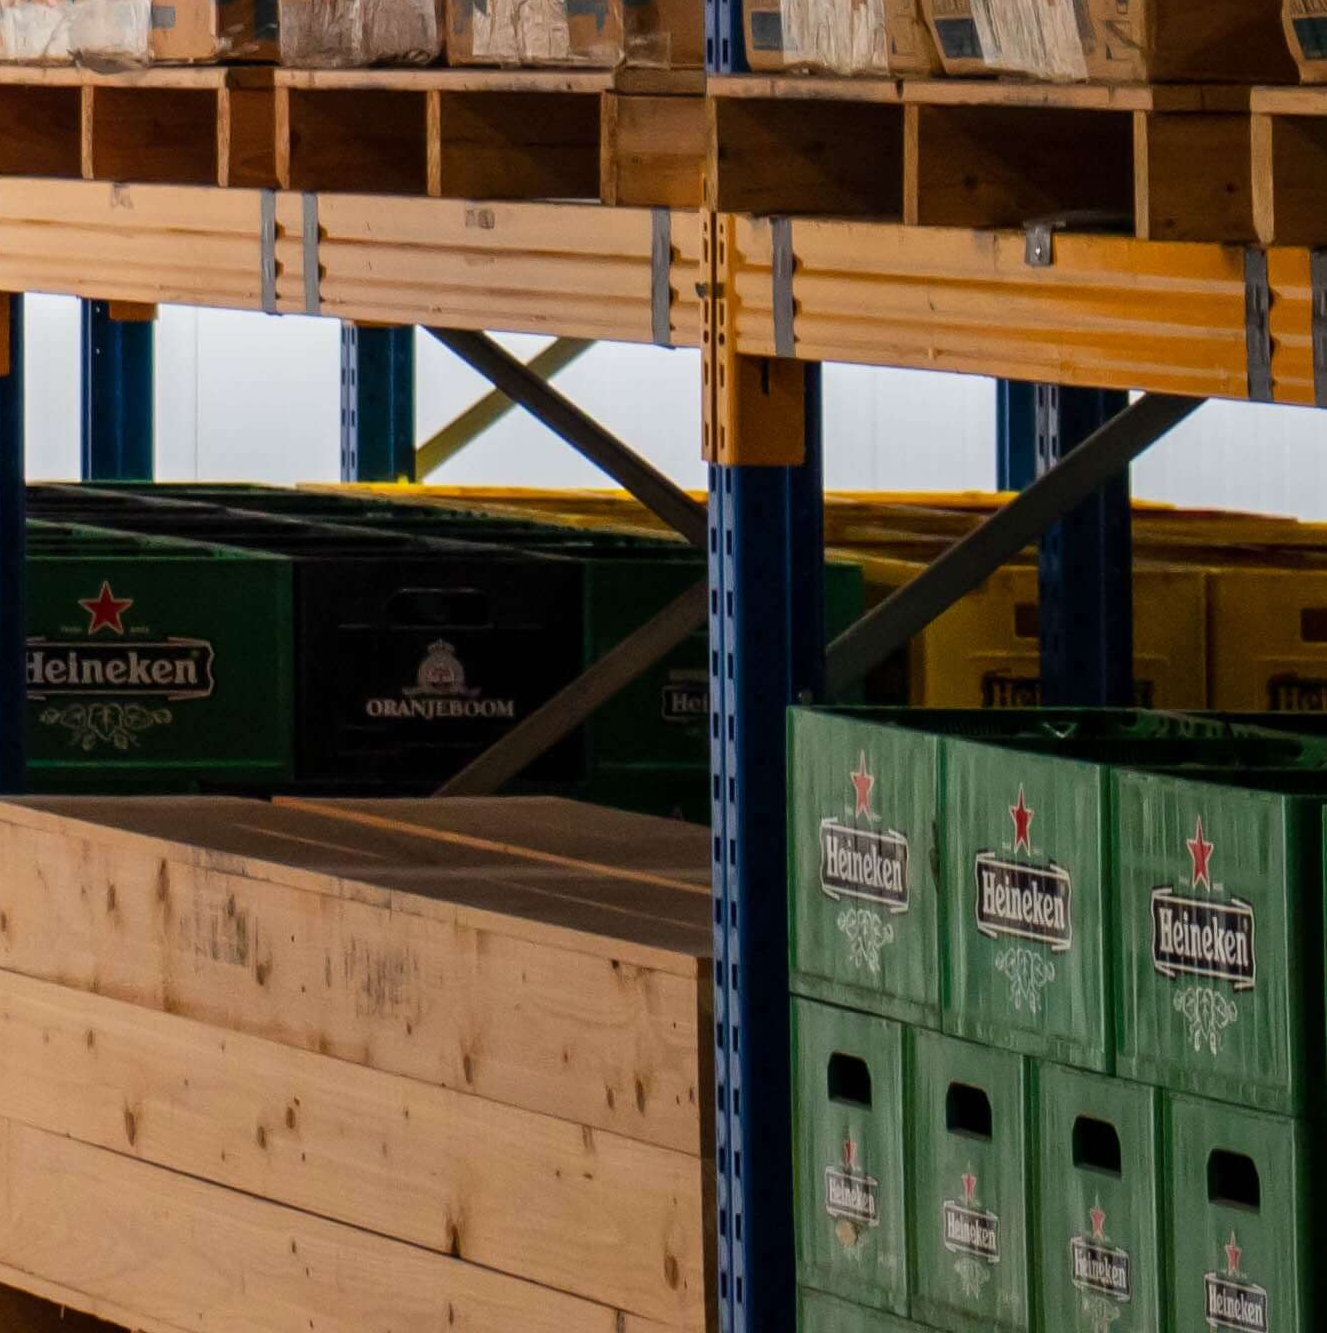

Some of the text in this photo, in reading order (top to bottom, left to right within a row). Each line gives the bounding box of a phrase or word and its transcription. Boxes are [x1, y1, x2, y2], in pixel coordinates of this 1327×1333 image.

[26, 651, 198, 686] Heineken
[366, 697, 515, 719] ORANJEBOOM
[826, 833, 902, 893] Heineken
[982, 865, 1065, 929] Heineken
[1159, 905, 1249, 968] Heineken
[1209, 1283, 1263, 1326] Heineken
